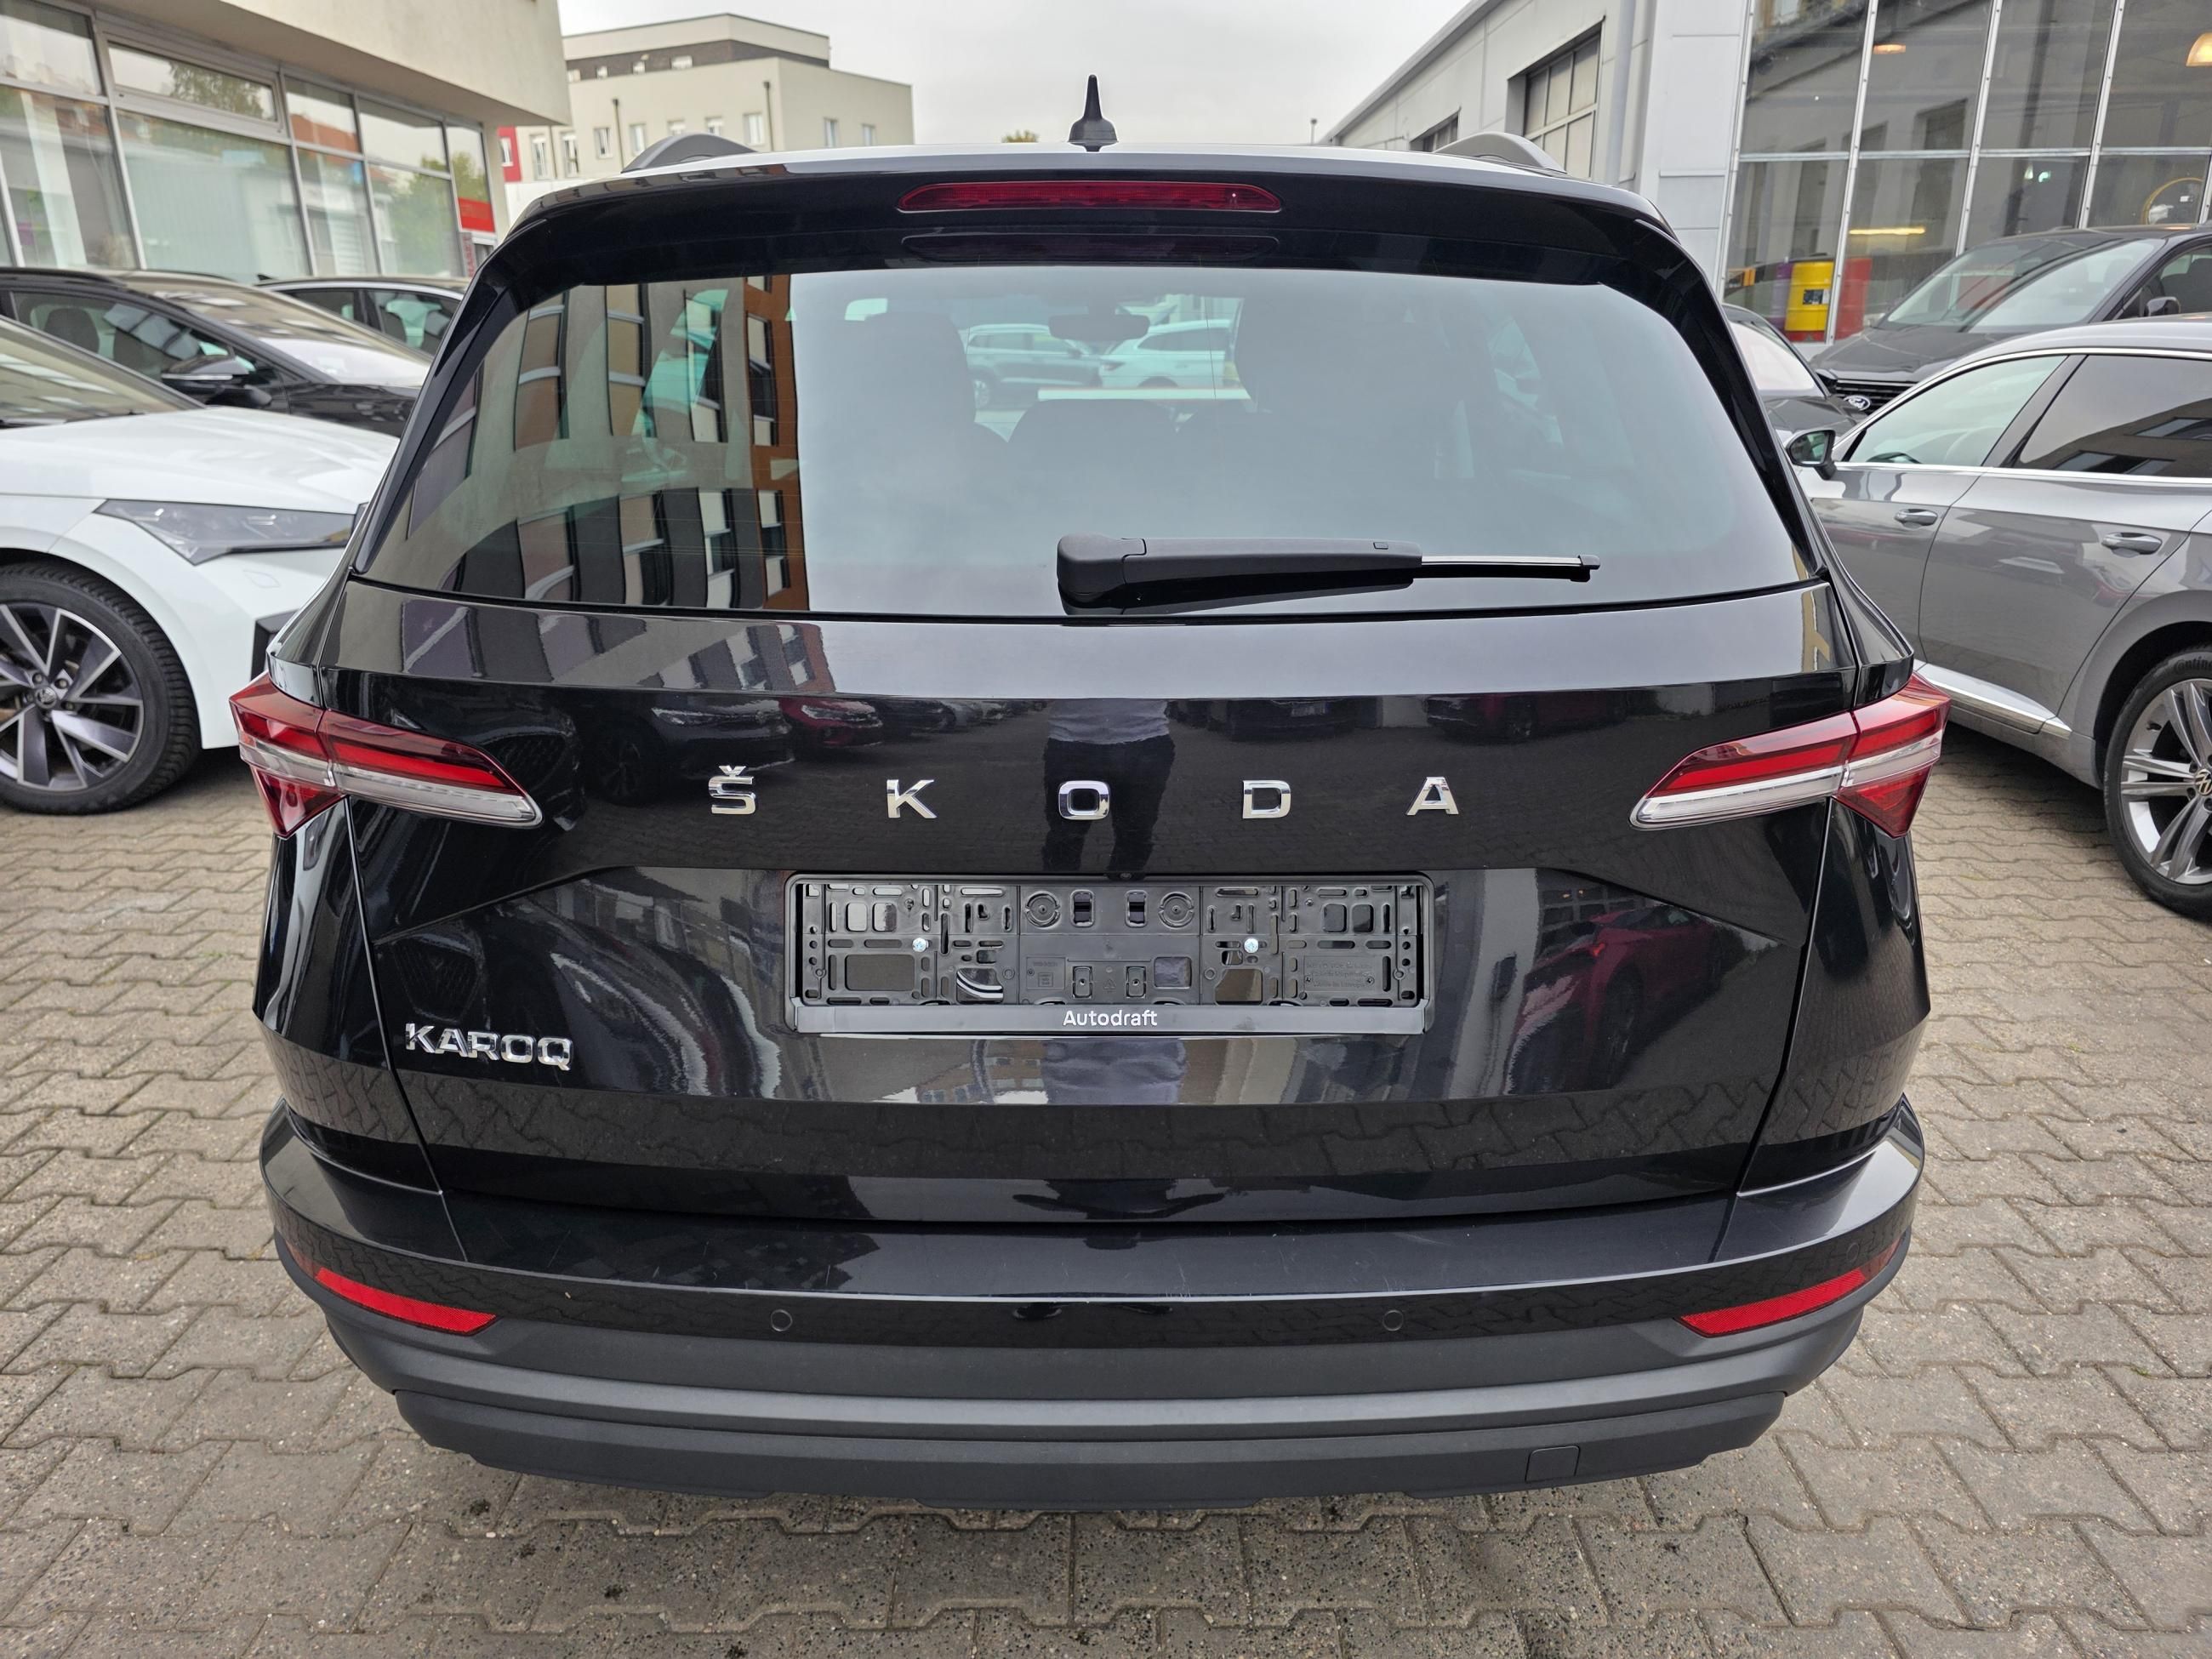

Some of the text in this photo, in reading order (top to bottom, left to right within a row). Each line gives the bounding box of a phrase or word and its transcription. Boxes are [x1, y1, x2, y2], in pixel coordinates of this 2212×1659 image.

[708, 765, 1460, 821] ŠKODA
[1063, 1009, 1158, 1027] Autodraft
[405, 1023, 573, 1071] KAROQ
